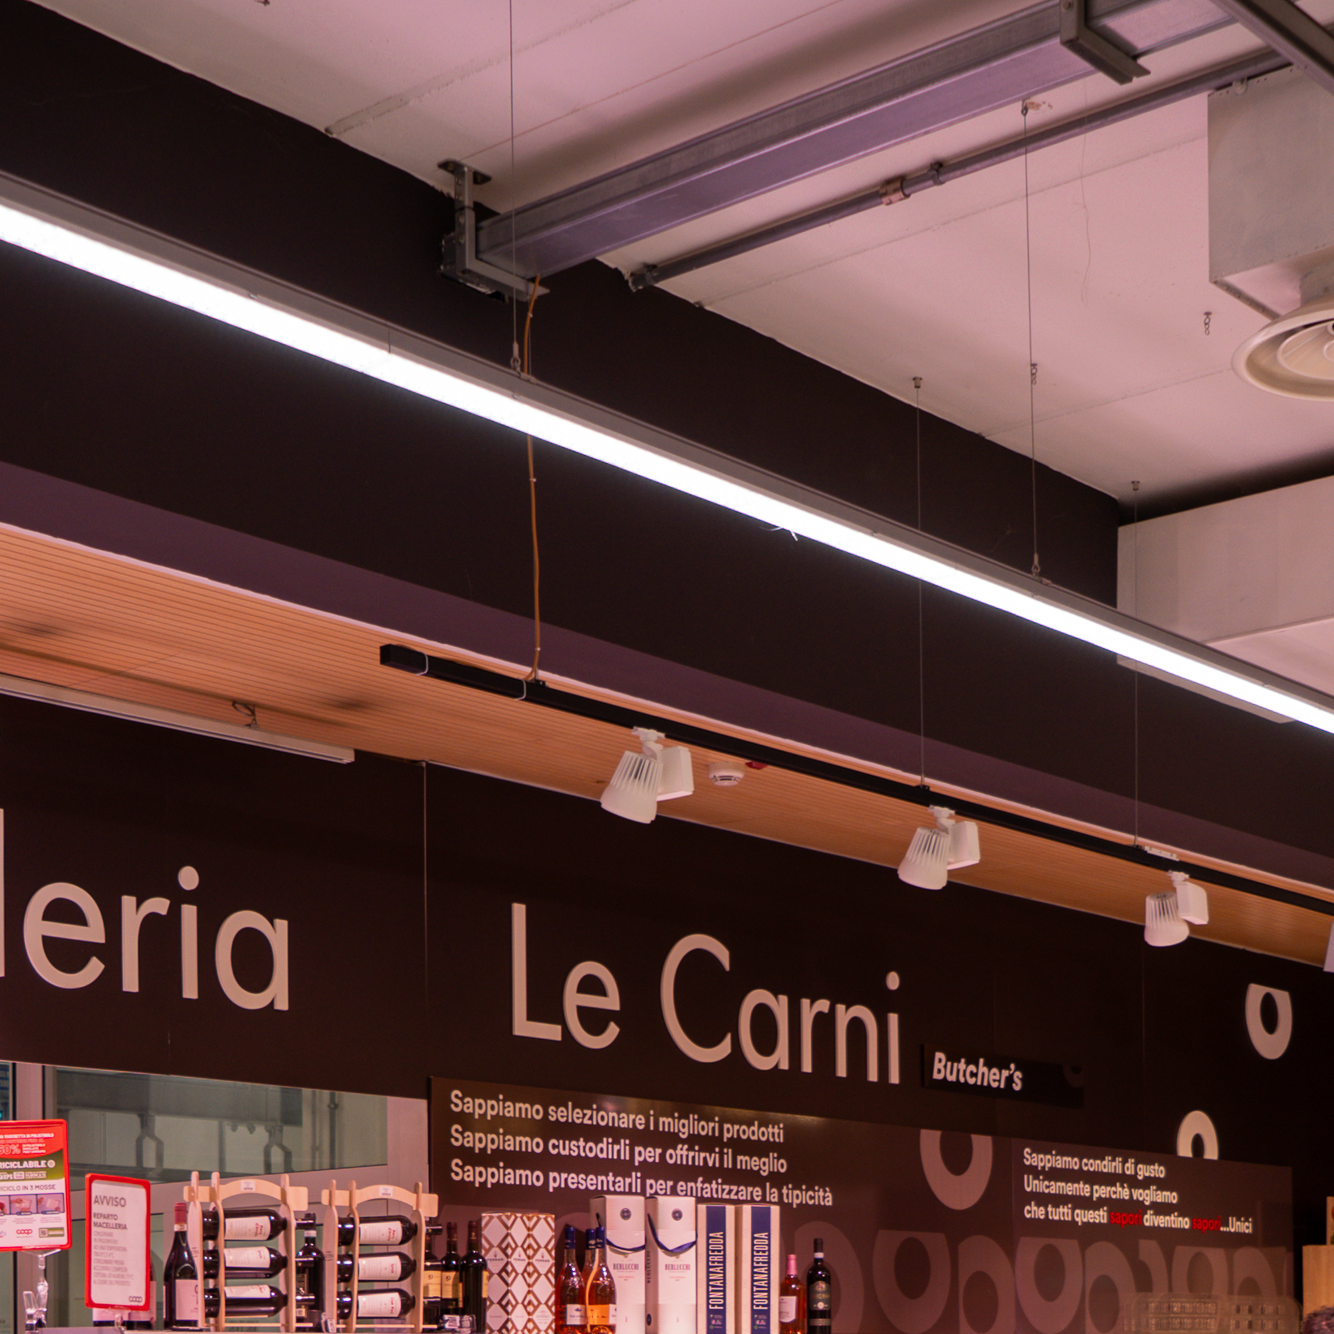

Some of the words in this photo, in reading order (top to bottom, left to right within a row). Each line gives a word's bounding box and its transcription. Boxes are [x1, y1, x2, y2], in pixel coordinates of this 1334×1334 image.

[510, 902, 621, 1050] Le
[660, 932, 901, 1085] Carni
[932, 1052, 1023, 1091] Butcher's
[451, 1090, 543, 1121] Sappiamo
[548, 1102, 645, 1130] selezionare
[650, 1110, 654, 1131] i
[659, 1111, 719, 1138] migliori
[723, 1117, 784, 1144] prodotti
[451, 1125, 543, 1154] Sappiamo
[548, 1138, 629, 1162] custodirli
[634, 1144, 662, 1166] per
[665, 1143, 719, 1168] offrirvi
[723, 1150, 732, 1169] il
[737, 1152, 787, 1177] meglio
[1023, 1148, 1079, 1172] Sappiamo
[1082, 1155, 1122, 1175] condirli
[1125, 1158, 1135, 1176] di
[1137, 1163, 1165, 1180] gusto
[451, 1159, 544, 1187] Sappiamo
[549, 1169, 641, 1194] presentarli
[646, 1176, 673, 1196] per
[677, 1176, 762, 1202] enfatizzare
[766, 1182, 779, 1202] la
[782, 1183, 833, 1207] tipicità
[1024, 1175, 1090, 1197] Unicamente
[1093, 1183, 1130, 1201] perchè
[1132, 1186, 1178, 1205] vogliamo
[94, 1195, 126, 1207] AVVISO
[1024, 1202, 1045, 1219] che
[1048, 1204, 1071, 1222] tutti
[1074, 1207, 1108, 1226] questi
[1110, 1209, 1142, 1228] sapori
[1143, 1210, 1190, 1229] diventino
[93, 1222, 127, 1230] MACELLERIA
[613, 1263, 639, 1271] BERLUCCHI
[665, 1263, 691, 1271] BERLUCCHI
[709, 1231, 724, 1310] FONTANAFREDDA
[753, 1232, 769, 1310] FONTANAFREDDA
